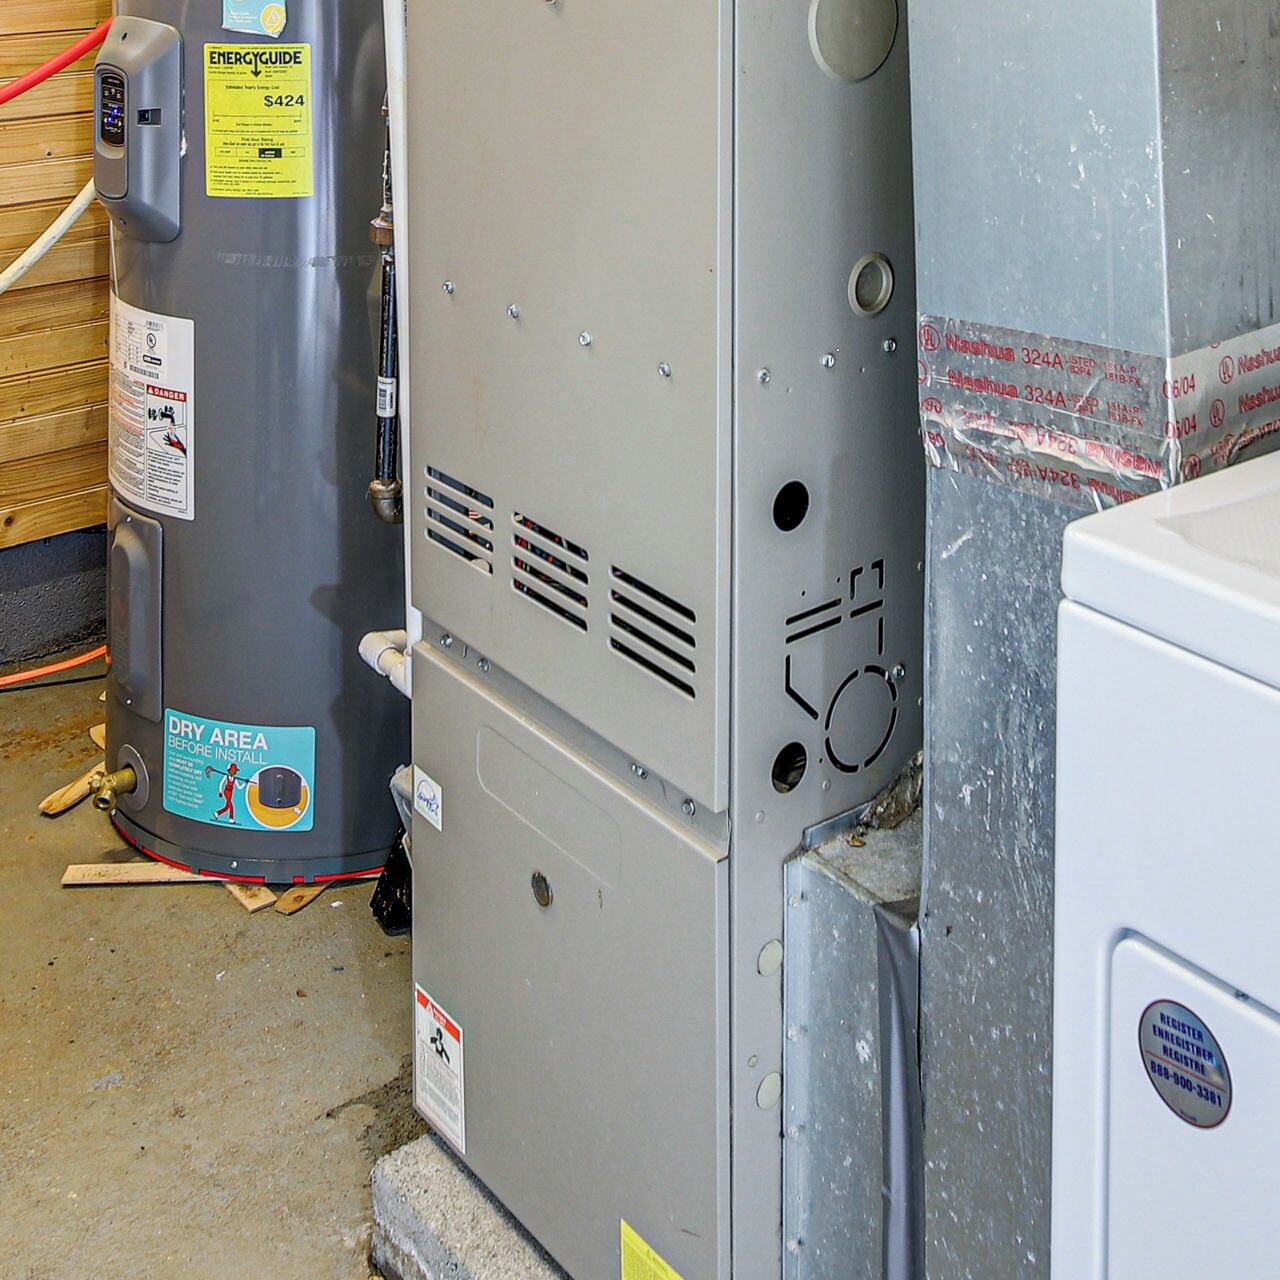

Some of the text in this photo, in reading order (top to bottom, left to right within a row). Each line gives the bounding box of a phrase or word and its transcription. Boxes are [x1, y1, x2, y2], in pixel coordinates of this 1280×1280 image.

[209, 51, 302, 65] ENERGYGUIDE
[264, 95, 305, 108] $424
[945, 332, 1015, 362] Nashua
[1021, 348, 1064, 369] 324A
[154, 388, 185, 400] DANGER
[947, 369, 1018, 399] Nashua
[1024, 385, 1067, 408] 324A
[1162, 373, 1195, 399] 06/04
[1085, 442, 1163, 479] Nashua
[1038, 466, 1081, 490] 324A
[169, 715, 268, 750] DRY AREA
[168, 734, 269, 765] BEFORE INSTALL
[1160, 1012, 1204, 1042] REGISTER
[1152, 1024, 1214, 1065] ENREGISTRER
[1162, 1044, 1207, 1076] REGISTRE
[1150, 1060, 1223, 1108] 888-900-3381
